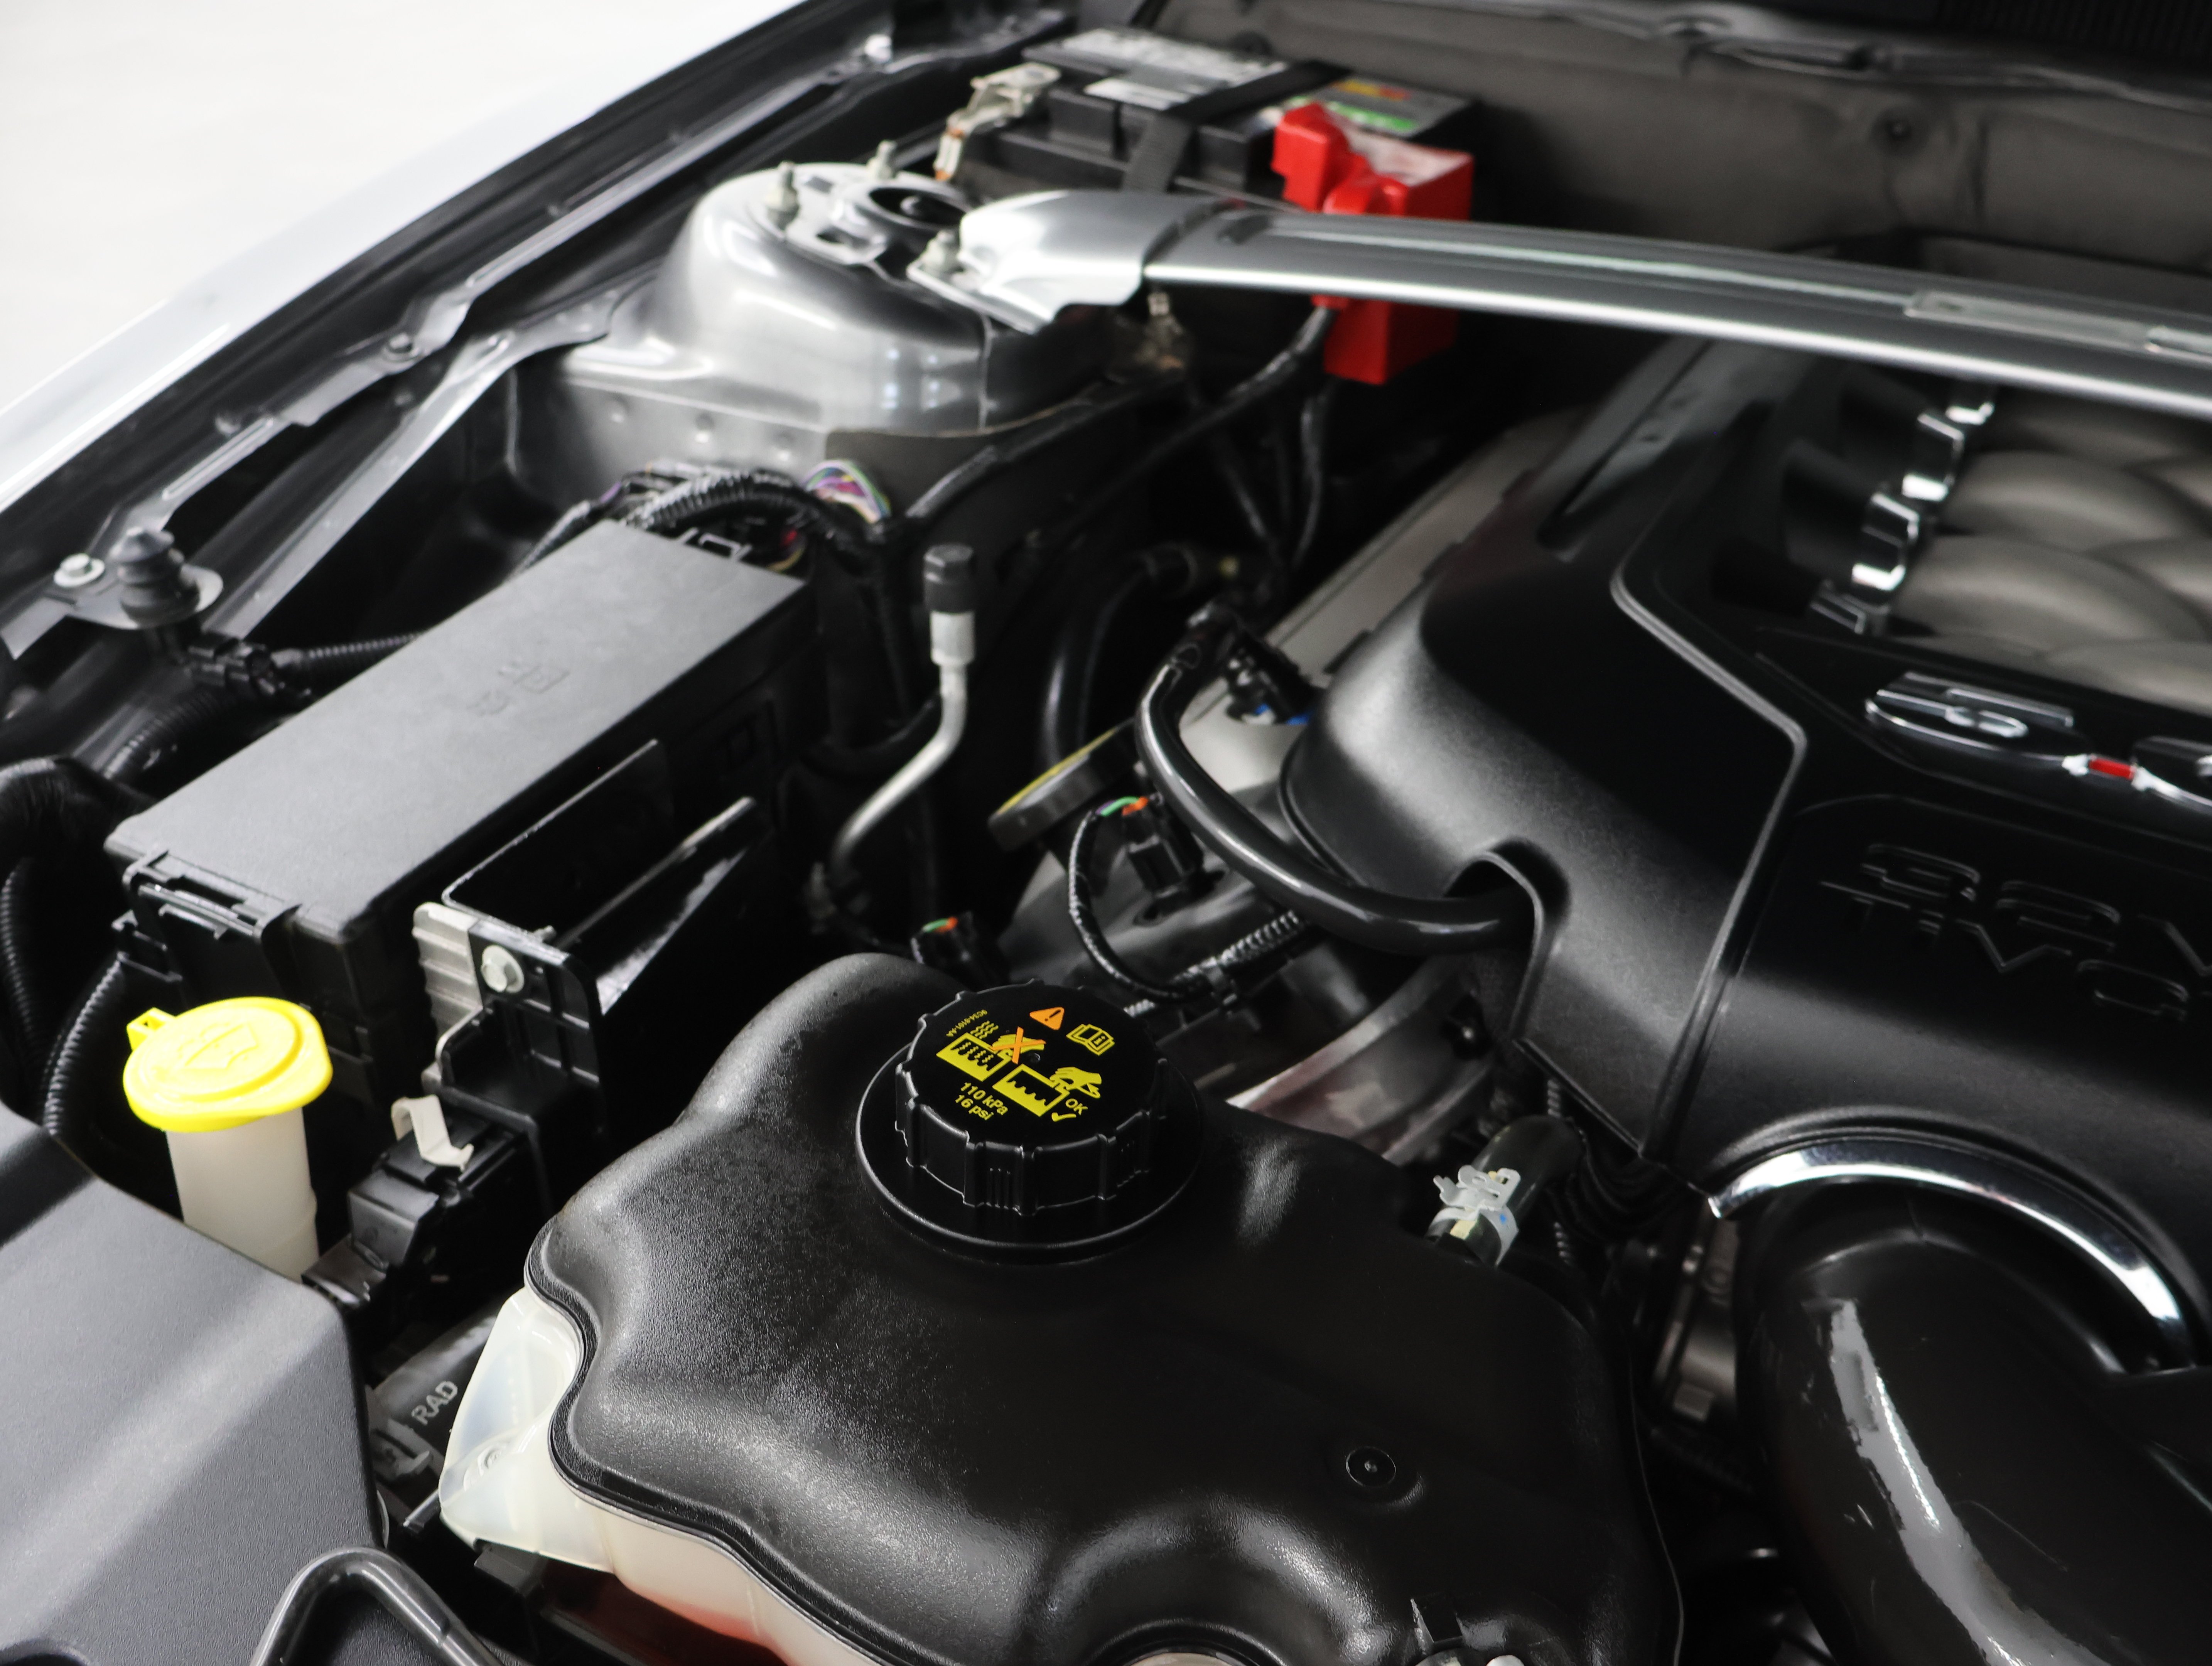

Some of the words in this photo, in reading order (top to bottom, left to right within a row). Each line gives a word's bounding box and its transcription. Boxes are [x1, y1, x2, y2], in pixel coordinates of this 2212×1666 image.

[955, 1095, 974, 1108] 16
[968, 1105, 994, 1121] psi
[960, 1082, 986, 1100] 110
[982, 1095, 1008, 1116] kPa
[1065, 1098, 1088, 1115] OK
[411, 1381, 458, 1425] RAD
